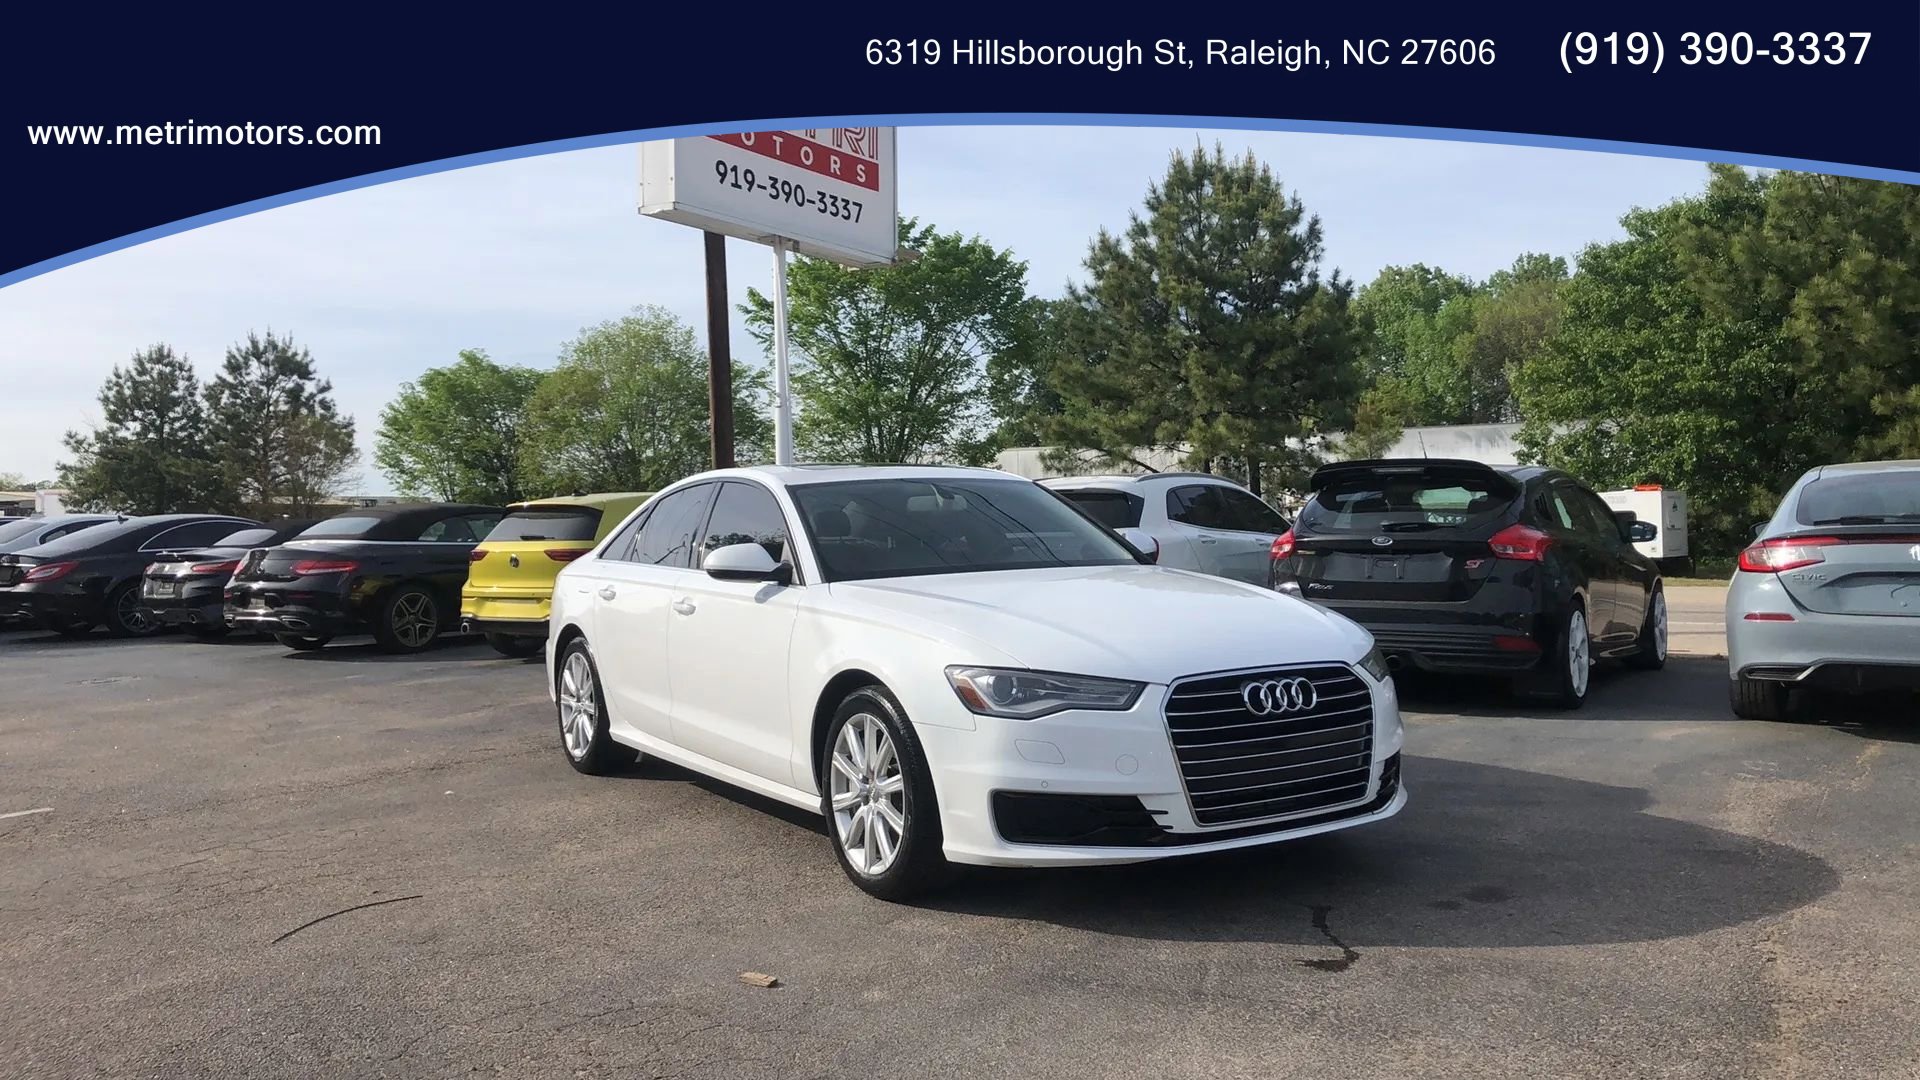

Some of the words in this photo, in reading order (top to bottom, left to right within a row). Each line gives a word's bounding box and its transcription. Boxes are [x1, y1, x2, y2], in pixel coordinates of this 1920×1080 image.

[740, 131, 867, 183] OTORS
[715, 159, 863, 224] 919-390-3337
[1792, 573, 1828, 581] CIVIC
